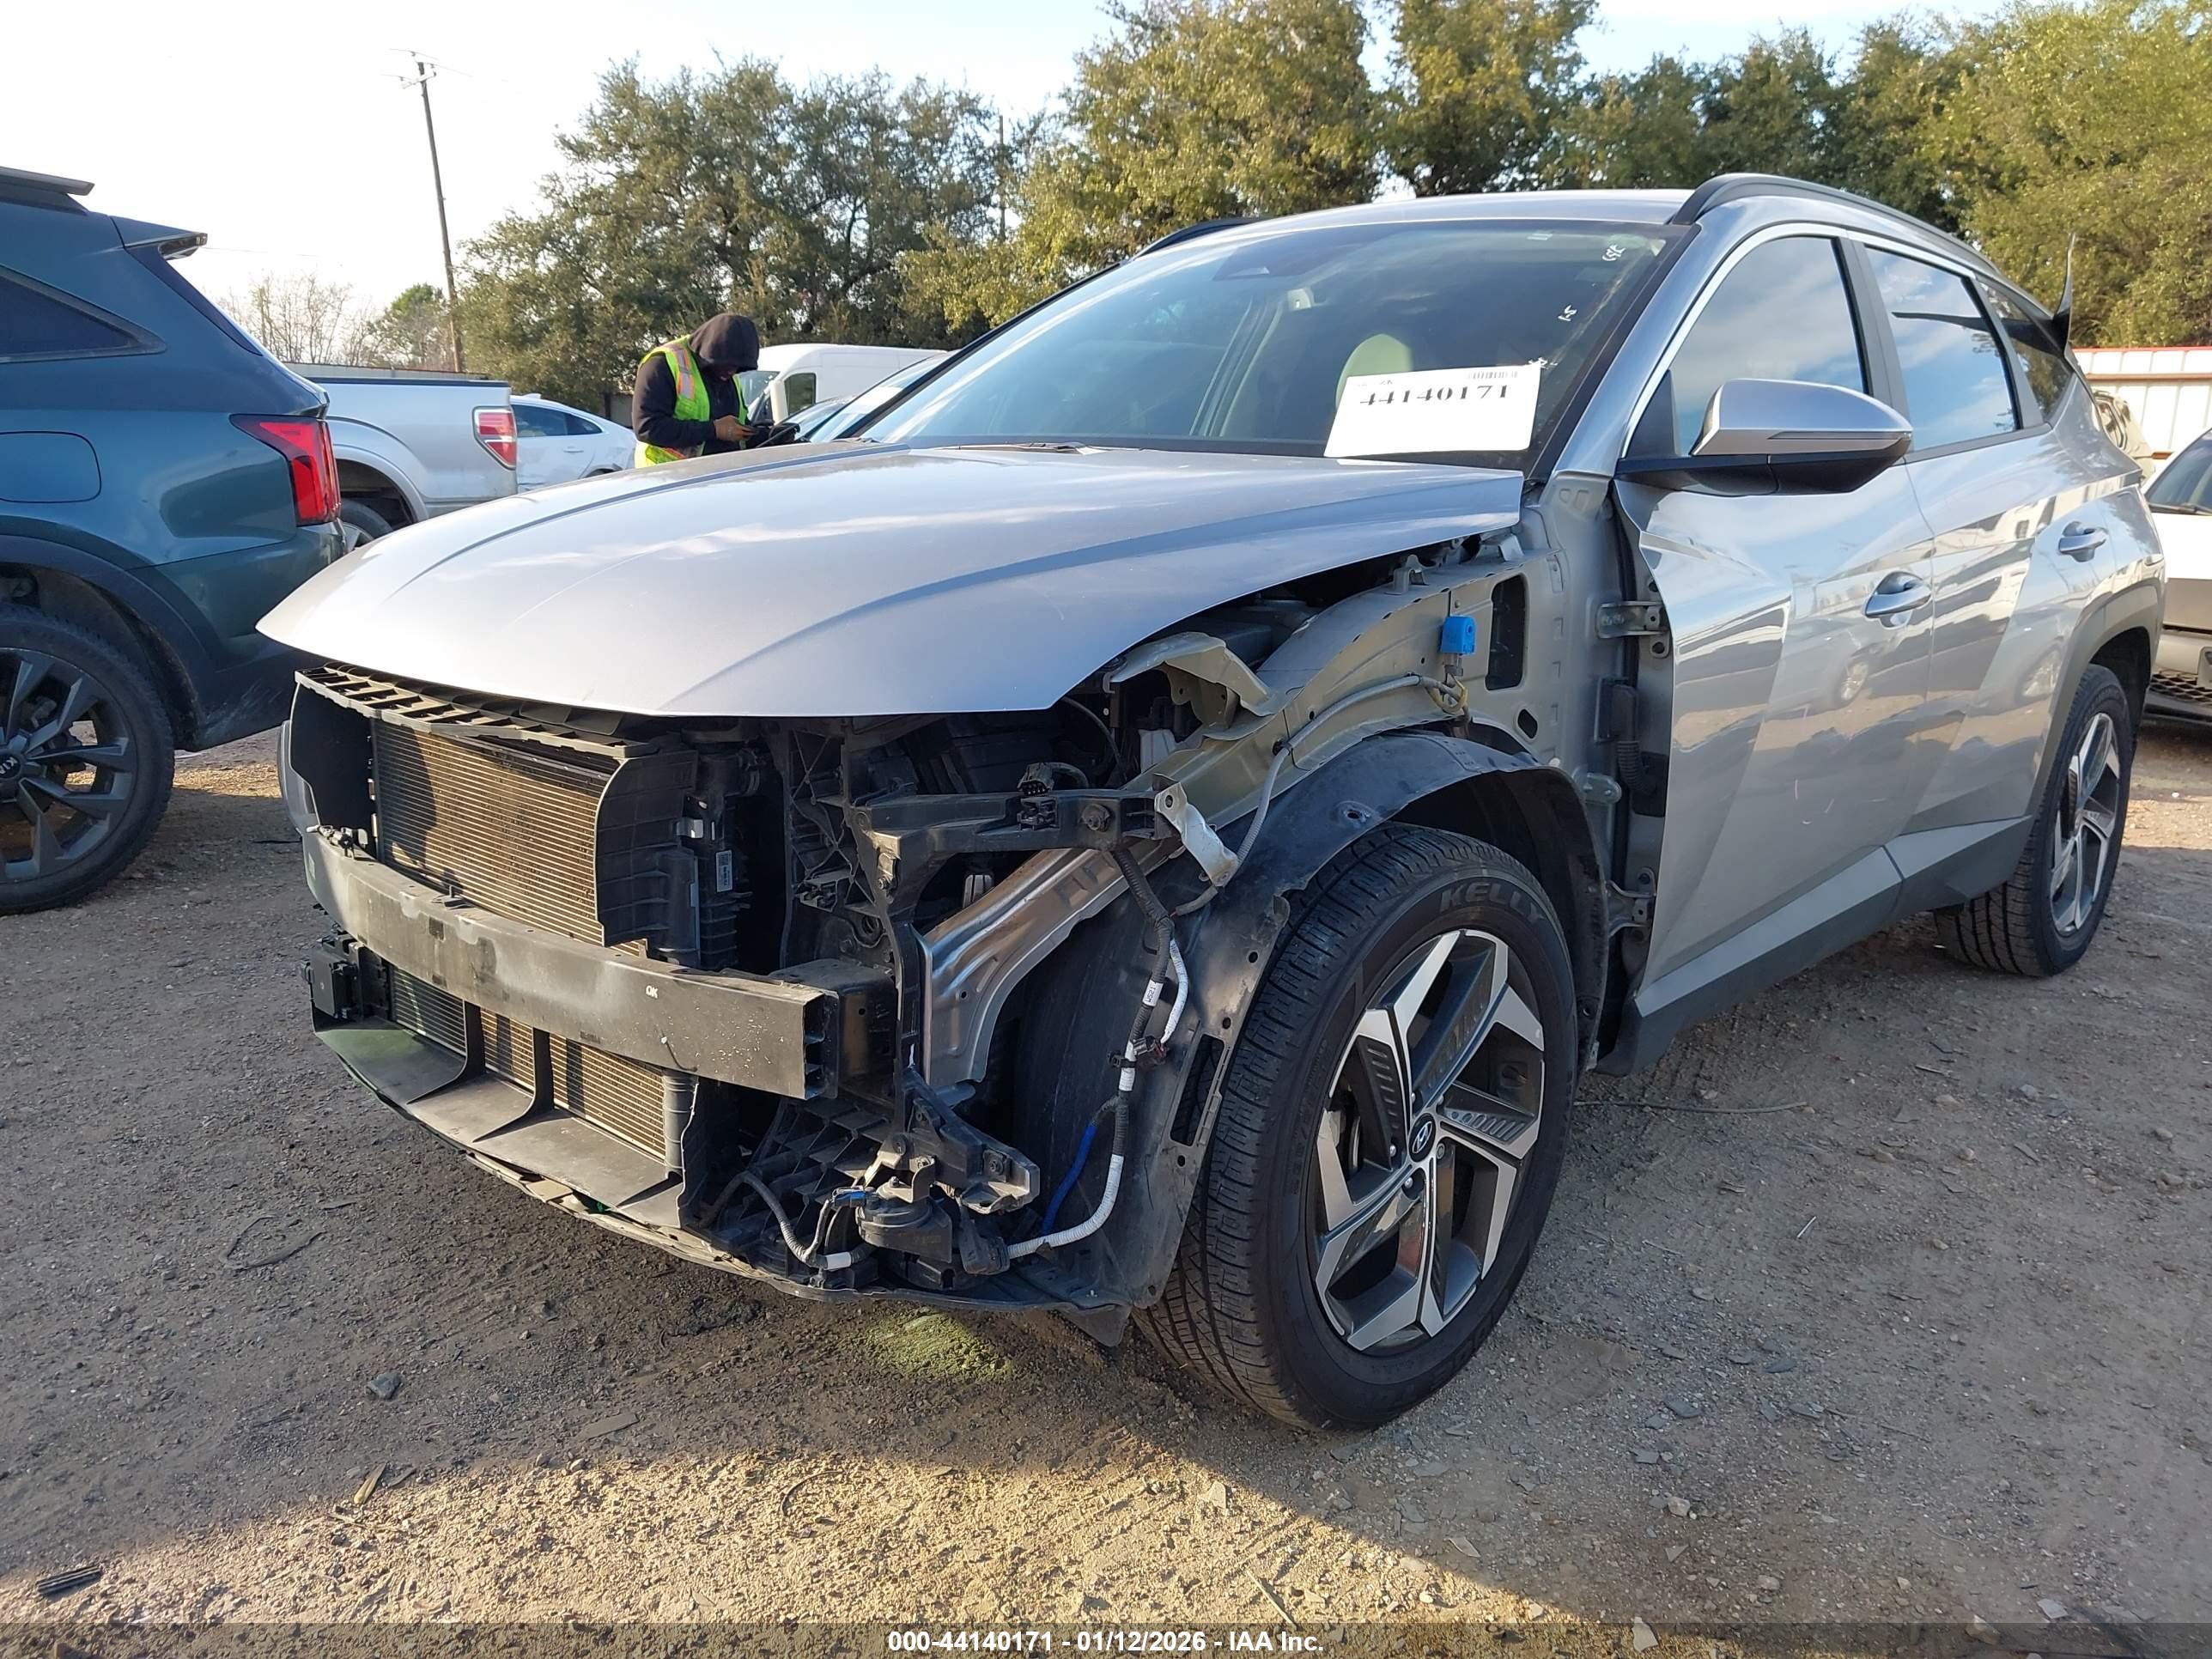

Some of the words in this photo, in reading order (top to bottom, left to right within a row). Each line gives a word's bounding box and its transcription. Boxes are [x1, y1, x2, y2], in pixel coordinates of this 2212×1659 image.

[1359, 384, 1509, 406] 44140171
[1437, 881, 1547, 926] KELLY
[645, 985, 659, 999] OK
